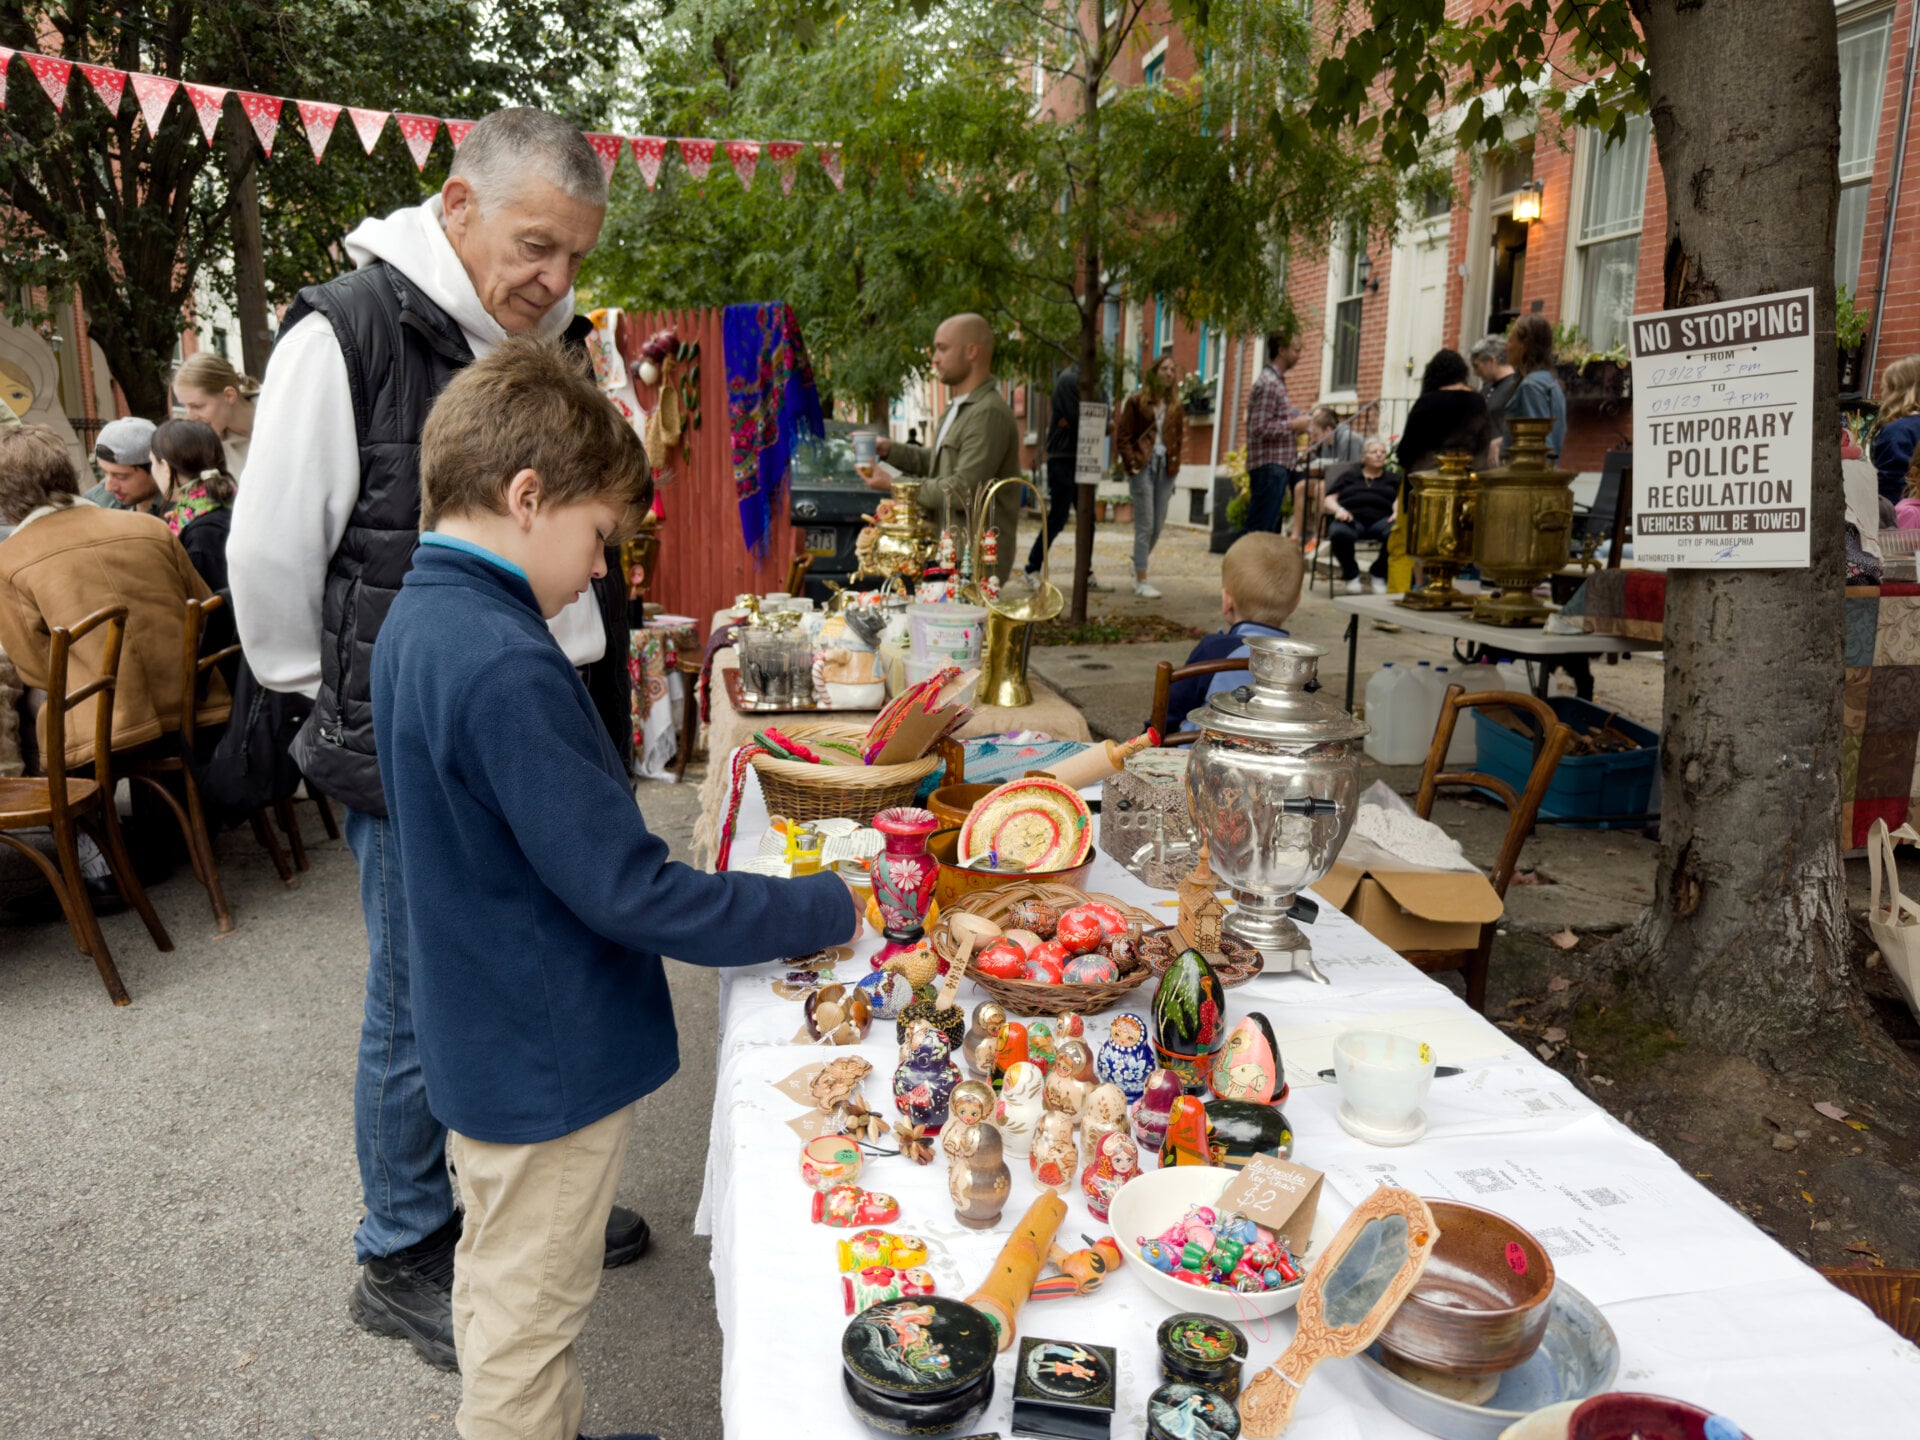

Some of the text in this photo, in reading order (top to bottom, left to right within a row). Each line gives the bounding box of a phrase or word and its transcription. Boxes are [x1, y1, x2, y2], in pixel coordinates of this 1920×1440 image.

[1639, 302, 1803, 353] NO STOPPING
[1703, 350, 1735, 362] FROM
[1711, 383, 1726, 393] TO
[1740, 392, 1770, 405] pm
[1649, 411, 1794, 446] TEMPORARY
[1667, 443, 1770, 478] POLICE
[1648, 480, 1793, 508] REGULATION
[1641, 512, 1800, 533] VEHICLES WILL BE TOWED
[1677, 537, 1754, 547] CITY OF PHILADELPHIA
[1637, 554, 1685, 563] AUTHORIZED BY
[1236, 1186, 1277, 1212] $2
